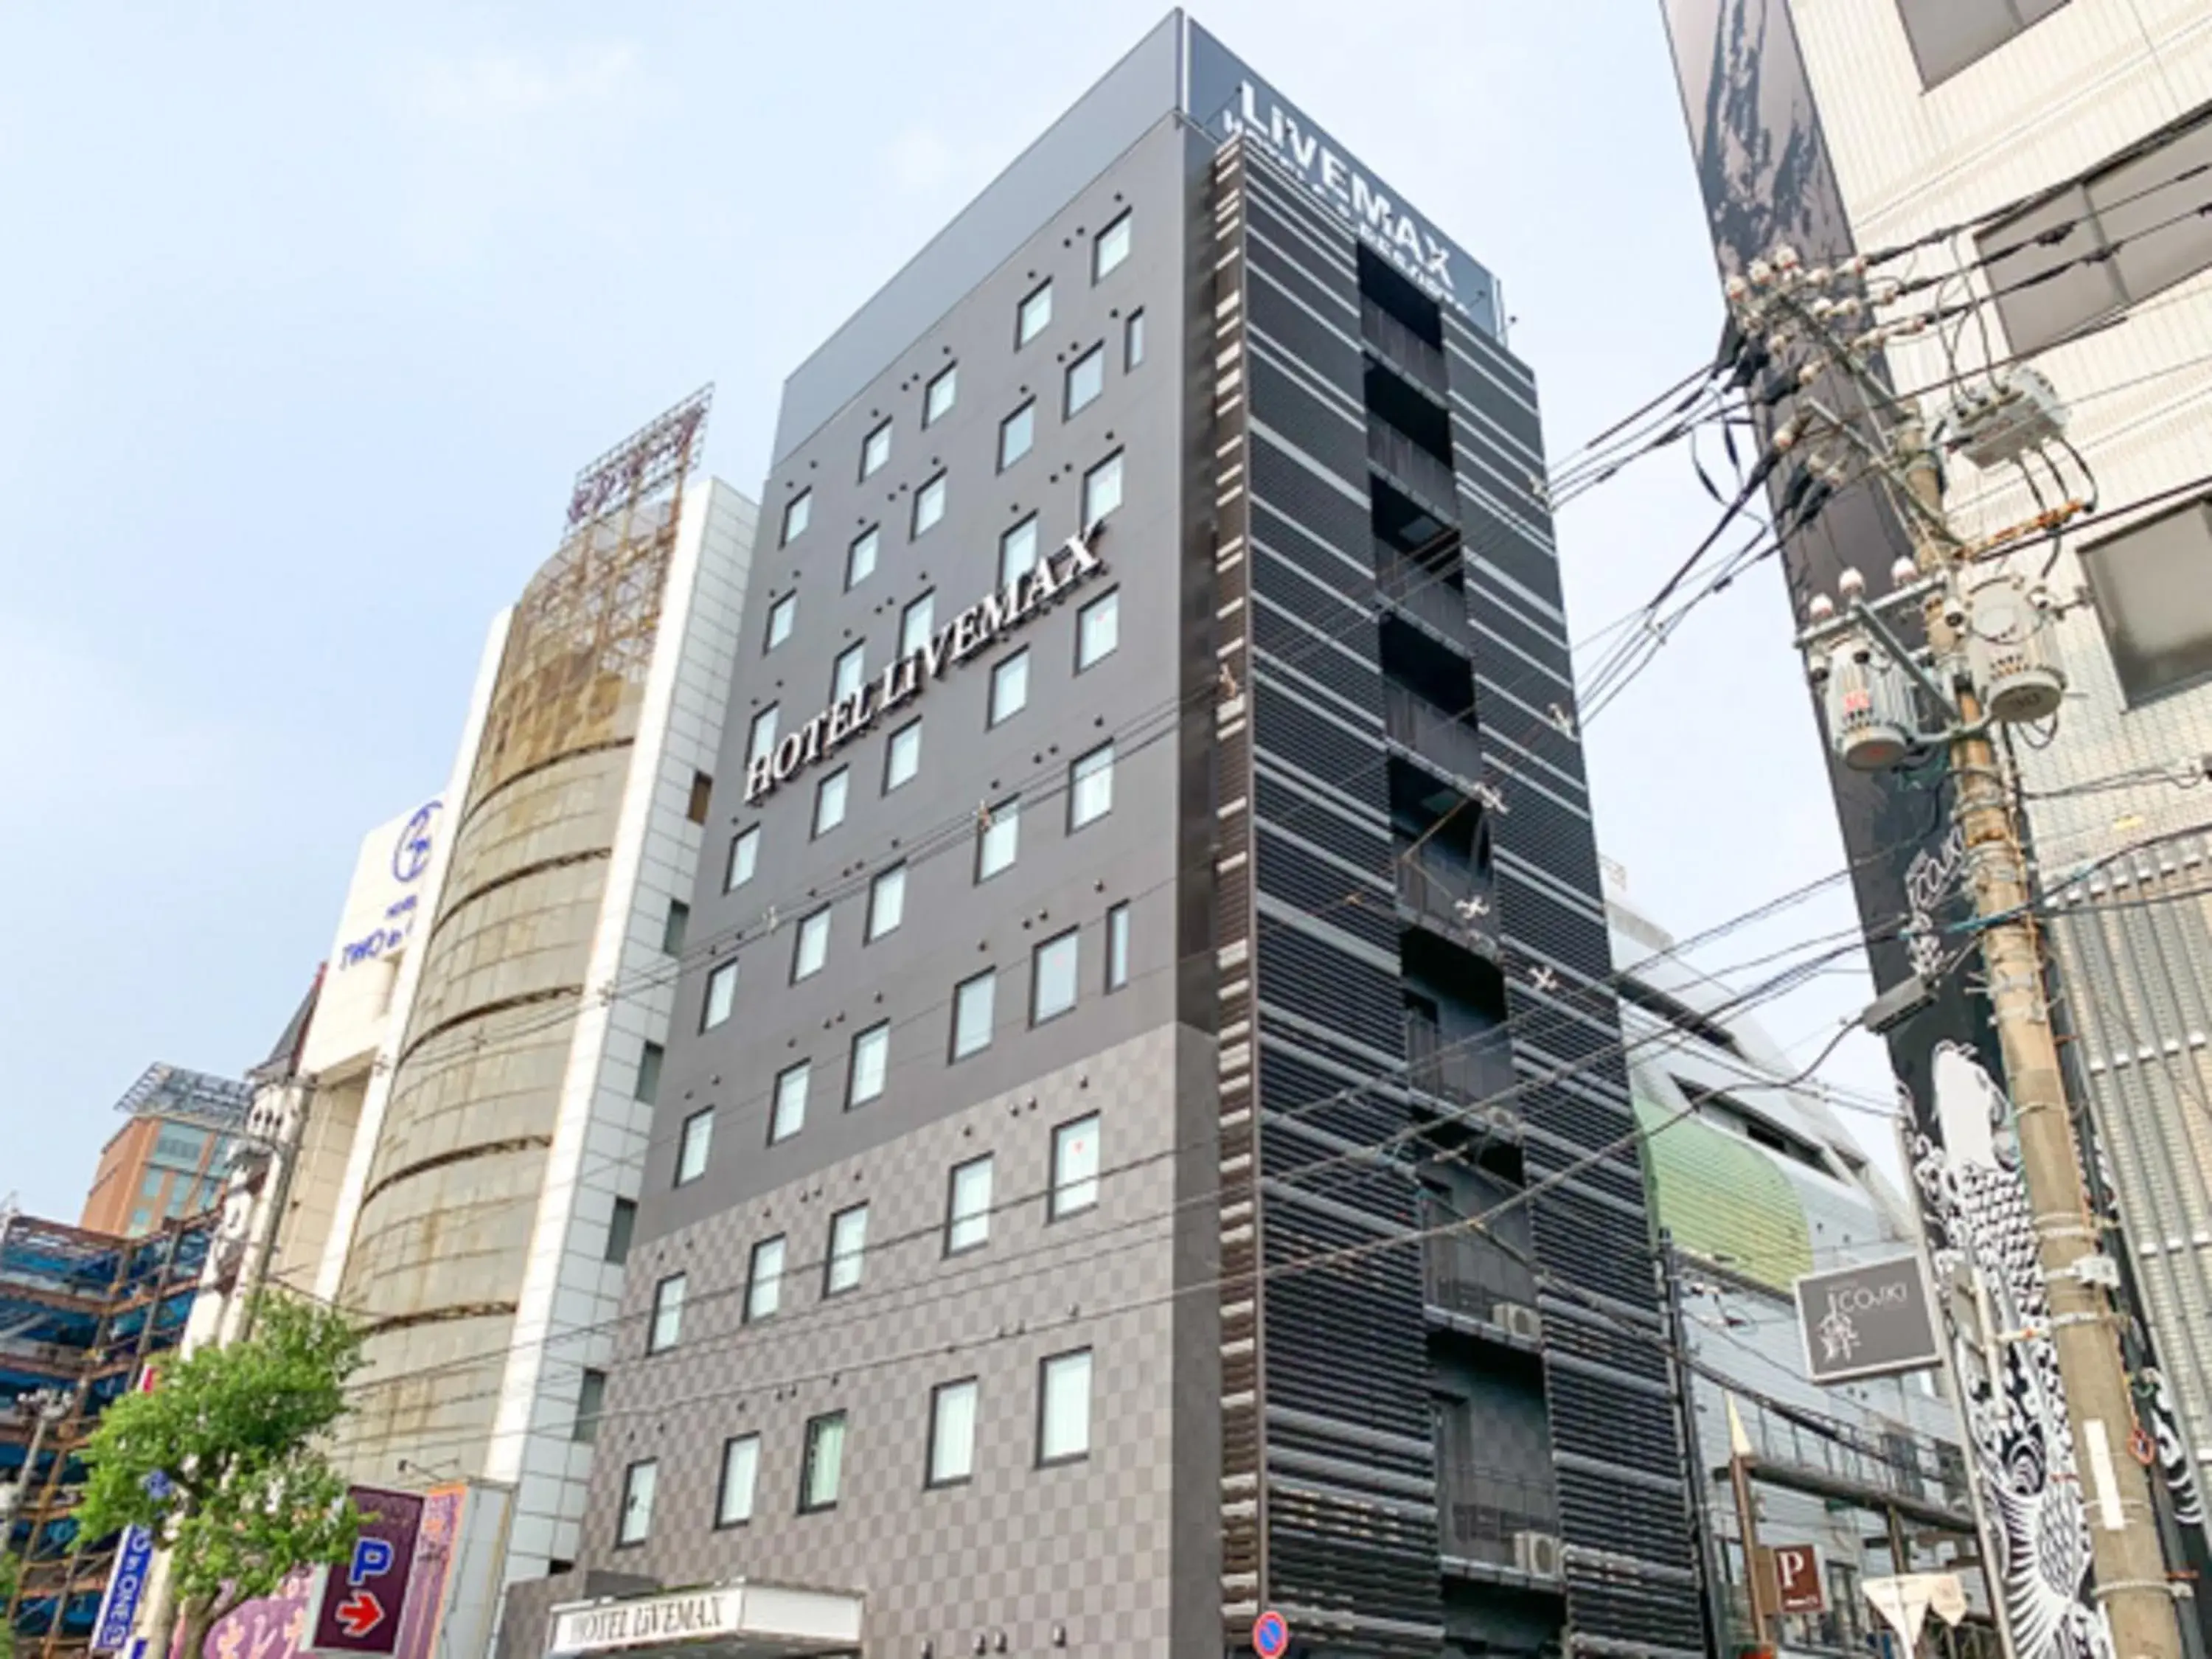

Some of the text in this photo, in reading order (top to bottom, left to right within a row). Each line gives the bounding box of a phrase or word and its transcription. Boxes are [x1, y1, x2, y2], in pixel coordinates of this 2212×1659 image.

[1241, 80, 1455, 290] LIVEMAX
[742, 519, 1107, 803] HOTEL LIVEMAX
[347, 1537, 395, 1585] P
[1778, 1551, 1804, 1590] P
